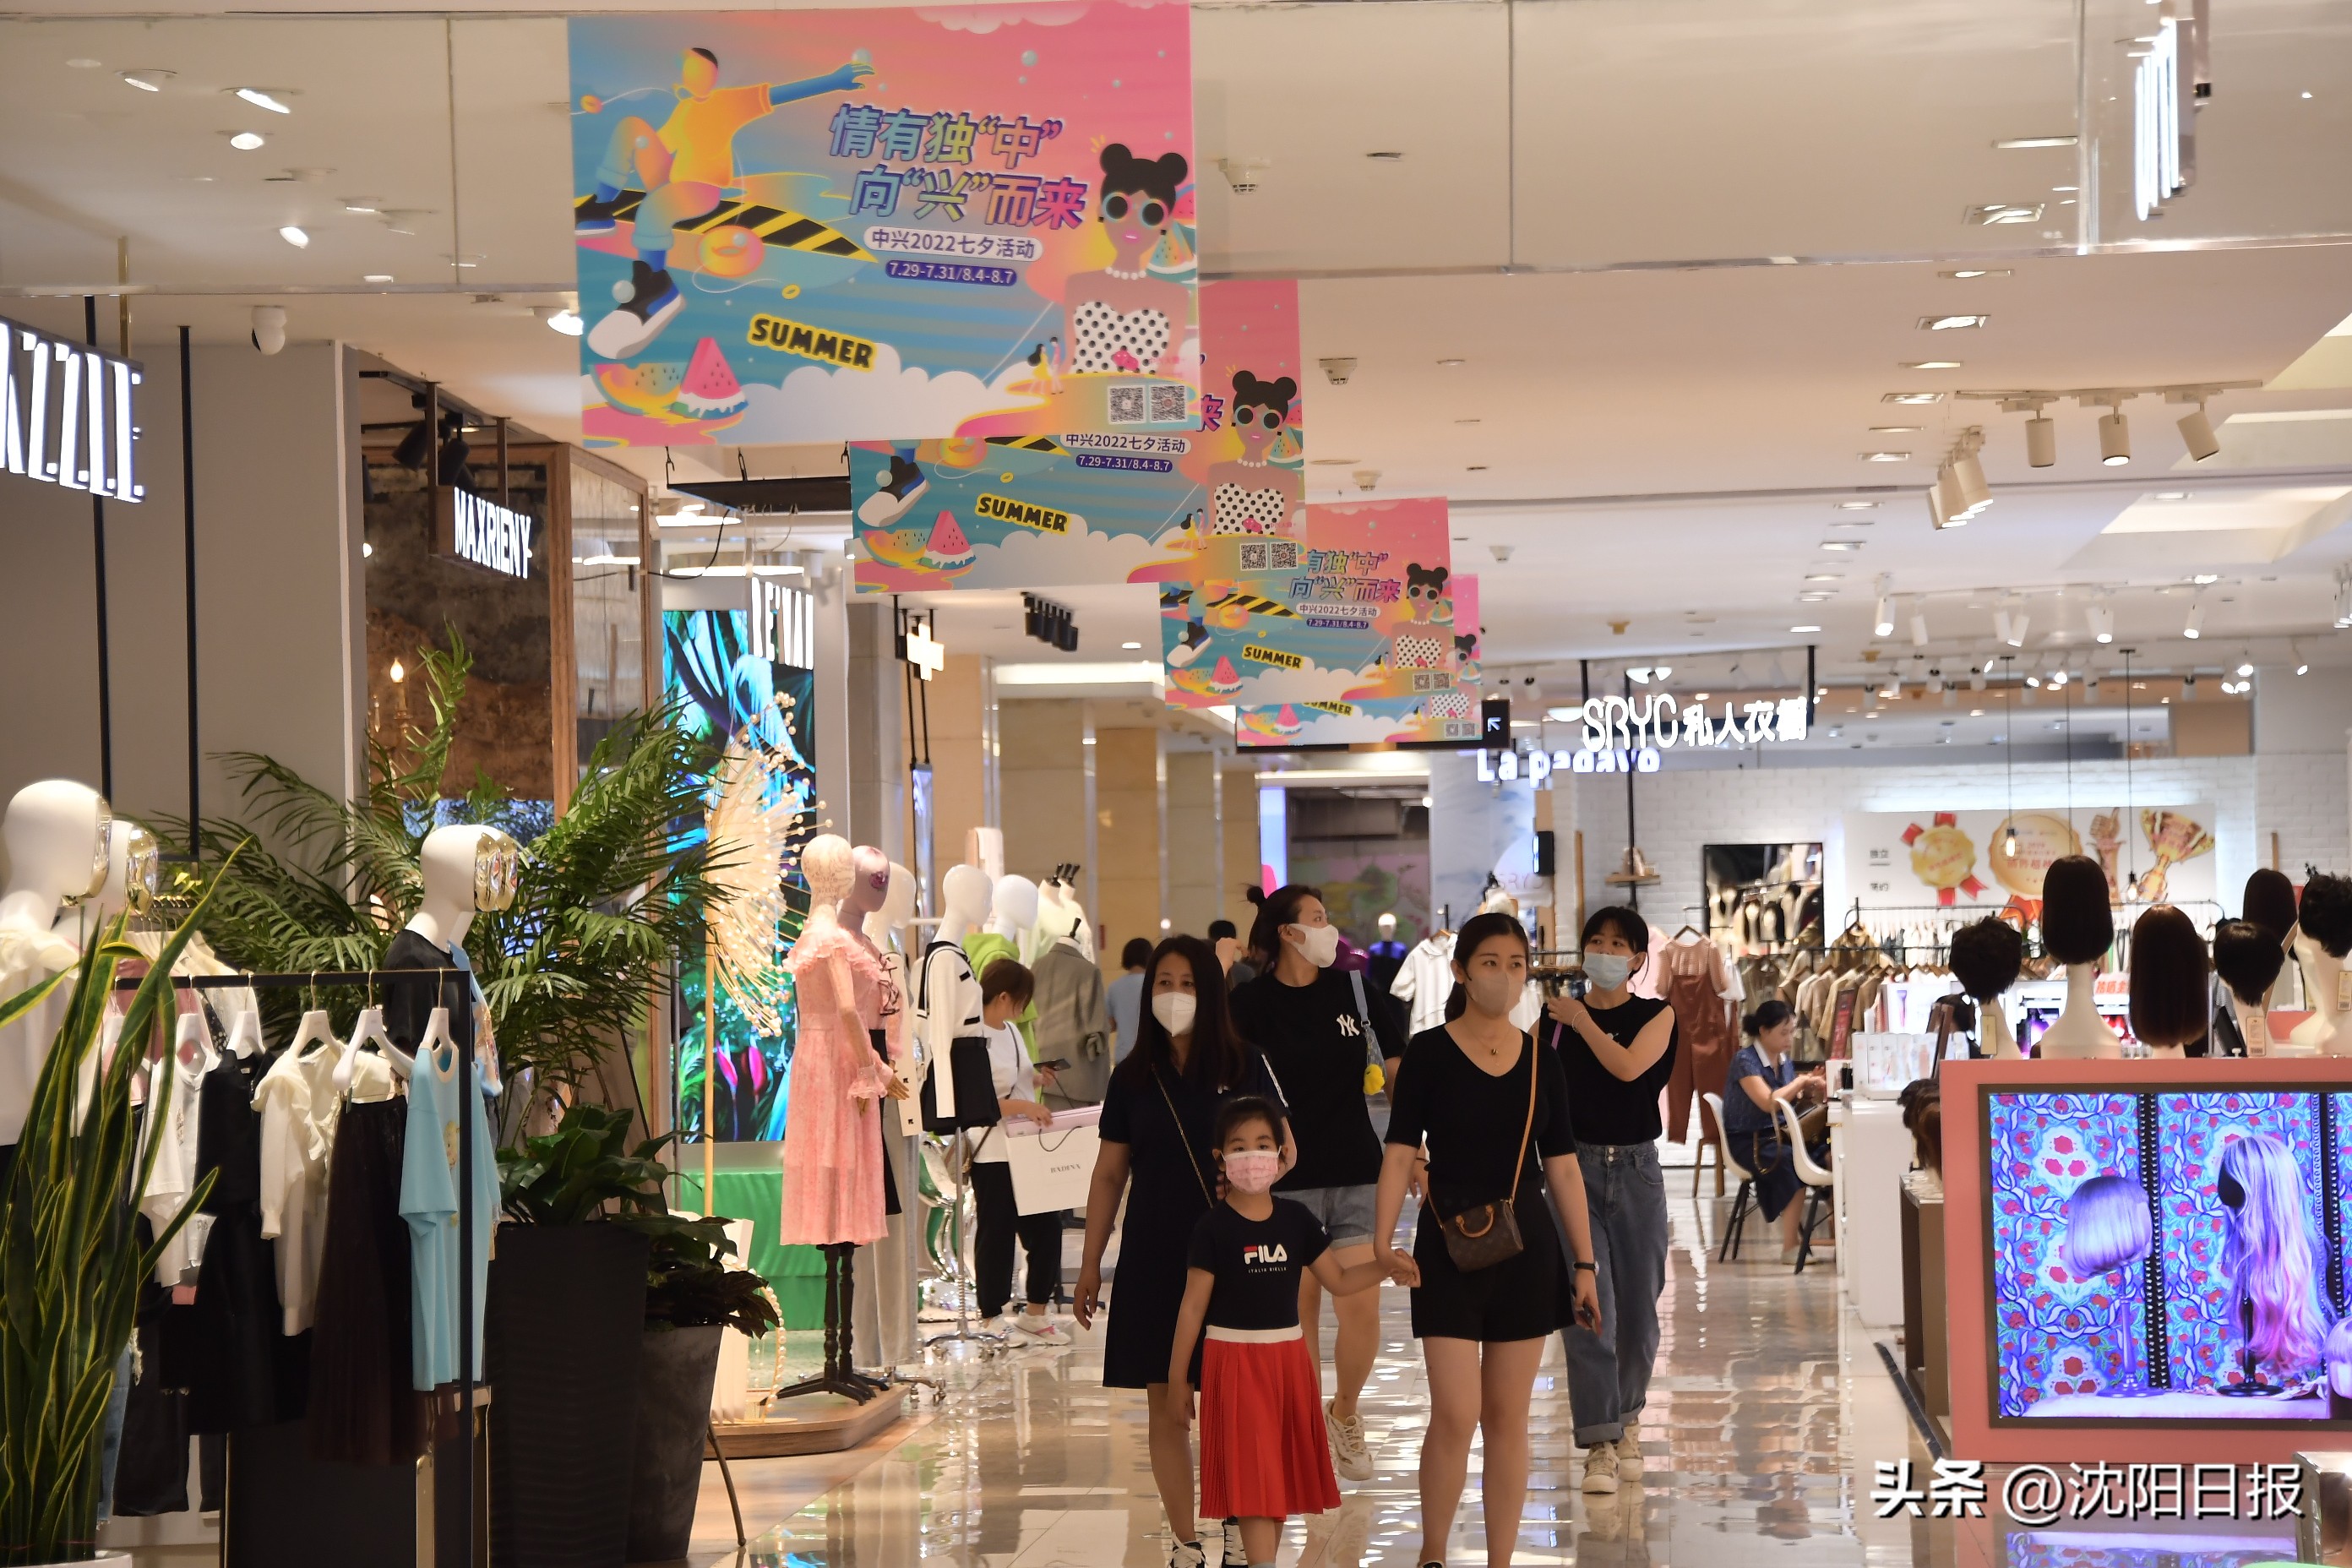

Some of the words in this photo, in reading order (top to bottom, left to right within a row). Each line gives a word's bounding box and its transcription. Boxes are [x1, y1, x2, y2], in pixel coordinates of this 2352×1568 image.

[829, 103, 1063, 169] 情有独“中”
[848, 164, 1088, 230] 向“兴”而来
[872, 228, 1035, 259] 中兴2022七夕活动
[890, 262, 1014, 285] 7.29-7.31/8.4-8.7
[752, 318, 874, 368] SUMMER
[1065, 433, 1185, 454] 中兴2022七夕活动
[1079, 455, 1170, 471] 7.29-7.31/8.4-8.7
[977, 496, 1068, 532] SUMMER
[454, 486, 531, 579] MAXRIENY
[1288, 576, 1402, 603] 向“兴”而来
[1299, 603, 1378, 618] 中兴2022七夕活动
[1308, 619, 1367, 629] 7.29-7.31/8.4-8.7
[1244, 646, 1302, 669] SUMMER
[1582, 693, 1680, 753] SRYC
[1476, 749, 1518, 782] La
[1337, 1014, 1360, 1037] NY
[1244, 1244, 1288, 1265] FILA
